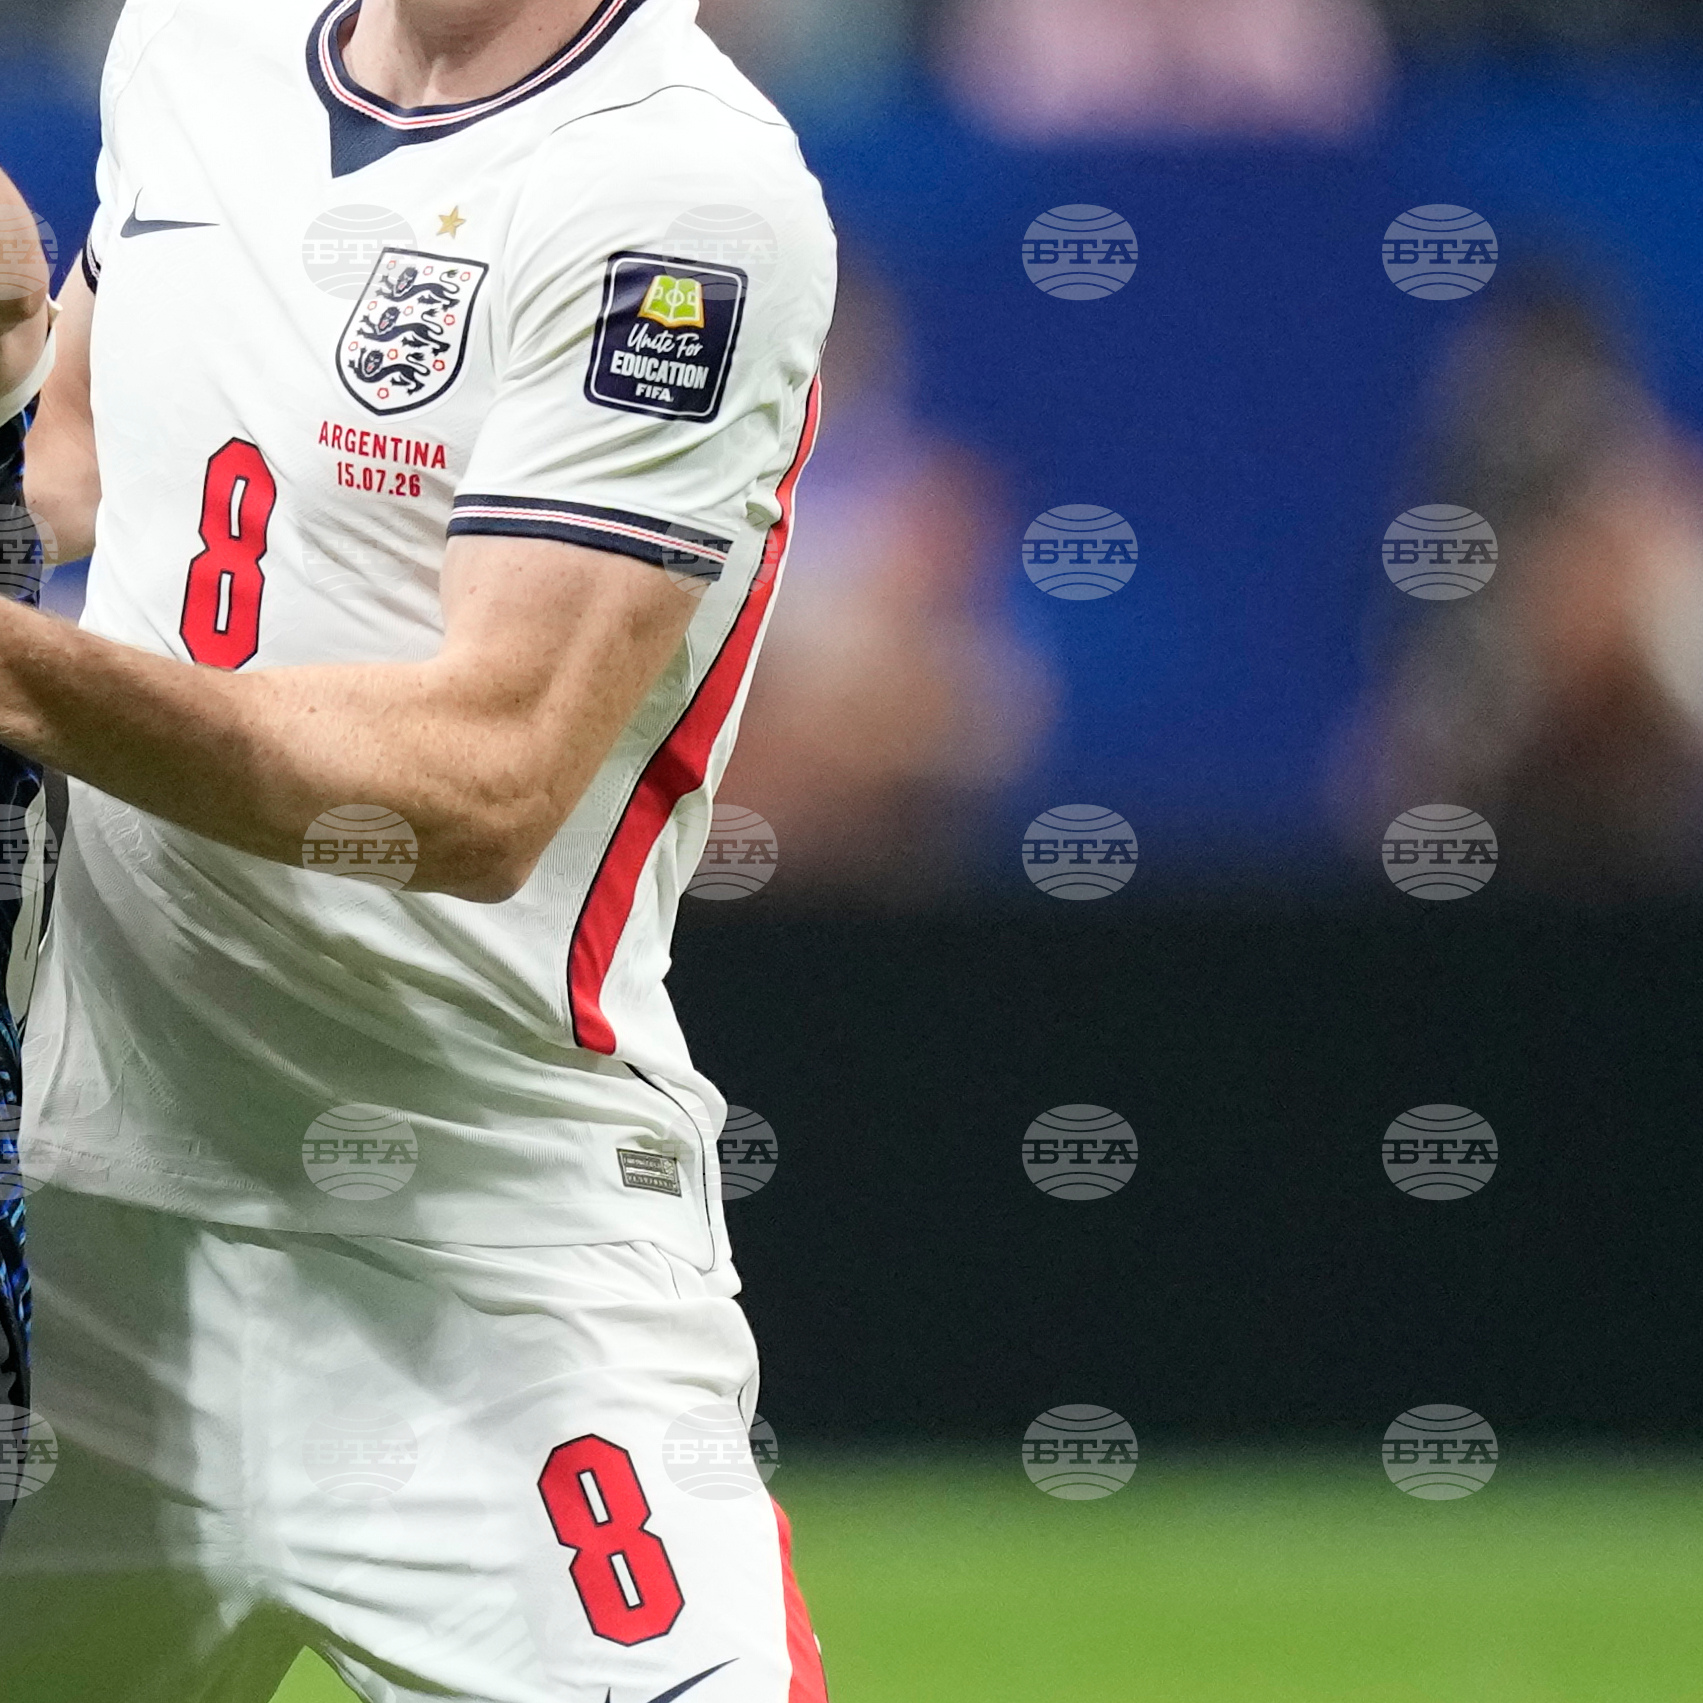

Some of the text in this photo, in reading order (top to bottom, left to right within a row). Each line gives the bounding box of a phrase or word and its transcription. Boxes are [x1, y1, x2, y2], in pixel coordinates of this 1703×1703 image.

[627, 323, 703, 359] Unite For
[610, 350, 709, 389] EDUCATION
[636, 383, 672, 402] FIFA
[319, 421, 446, 469] ARGENTINA
[337, 461, 421, 497] 15.07.26
[179, 436, 277, 670] 8
[536, 1432, 685, 1646] 8
